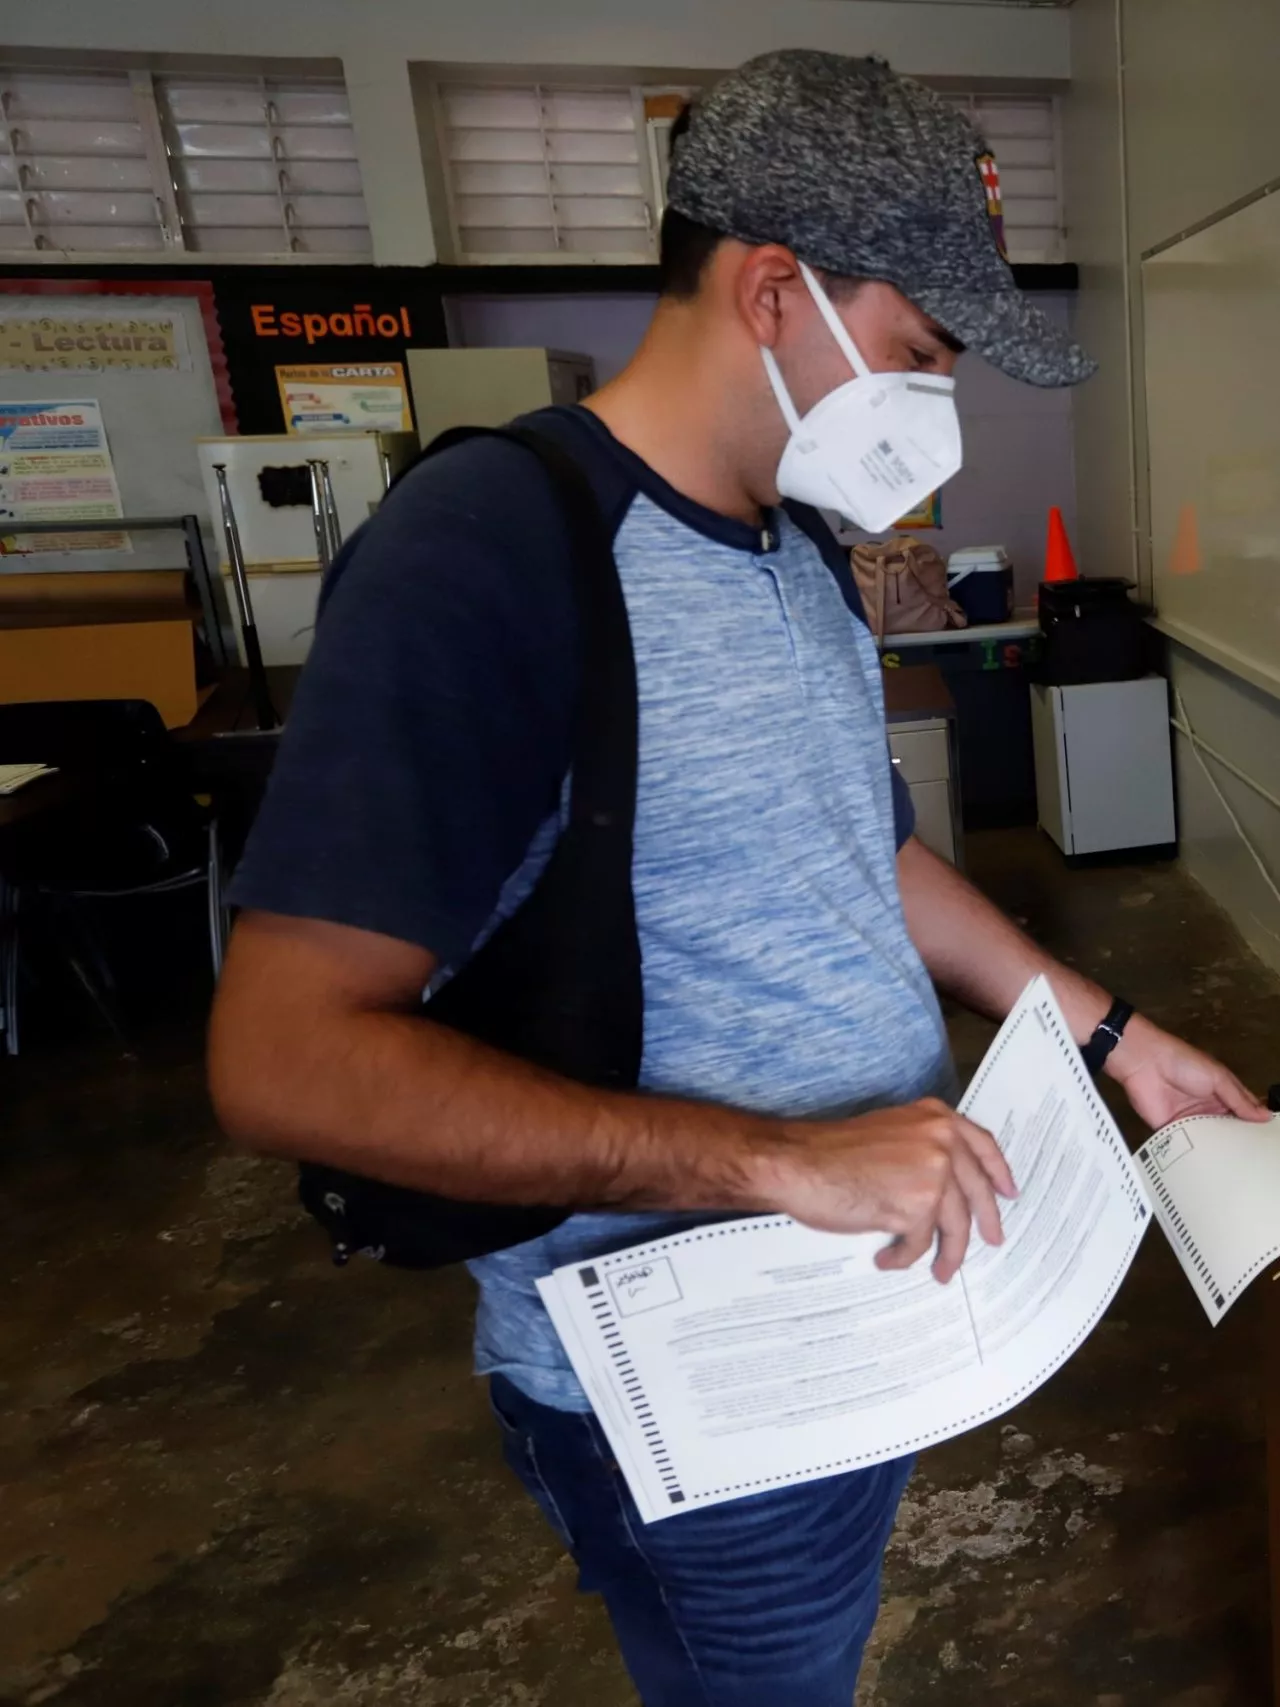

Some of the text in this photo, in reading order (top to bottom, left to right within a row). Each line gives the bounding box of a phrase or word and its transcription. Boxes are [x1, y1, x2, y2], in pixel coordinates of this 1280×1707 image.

[250, 303, 413, 345] Español
[32, 331, 168, 352] Lectura
[331, 366, 397, 379] CARTA
